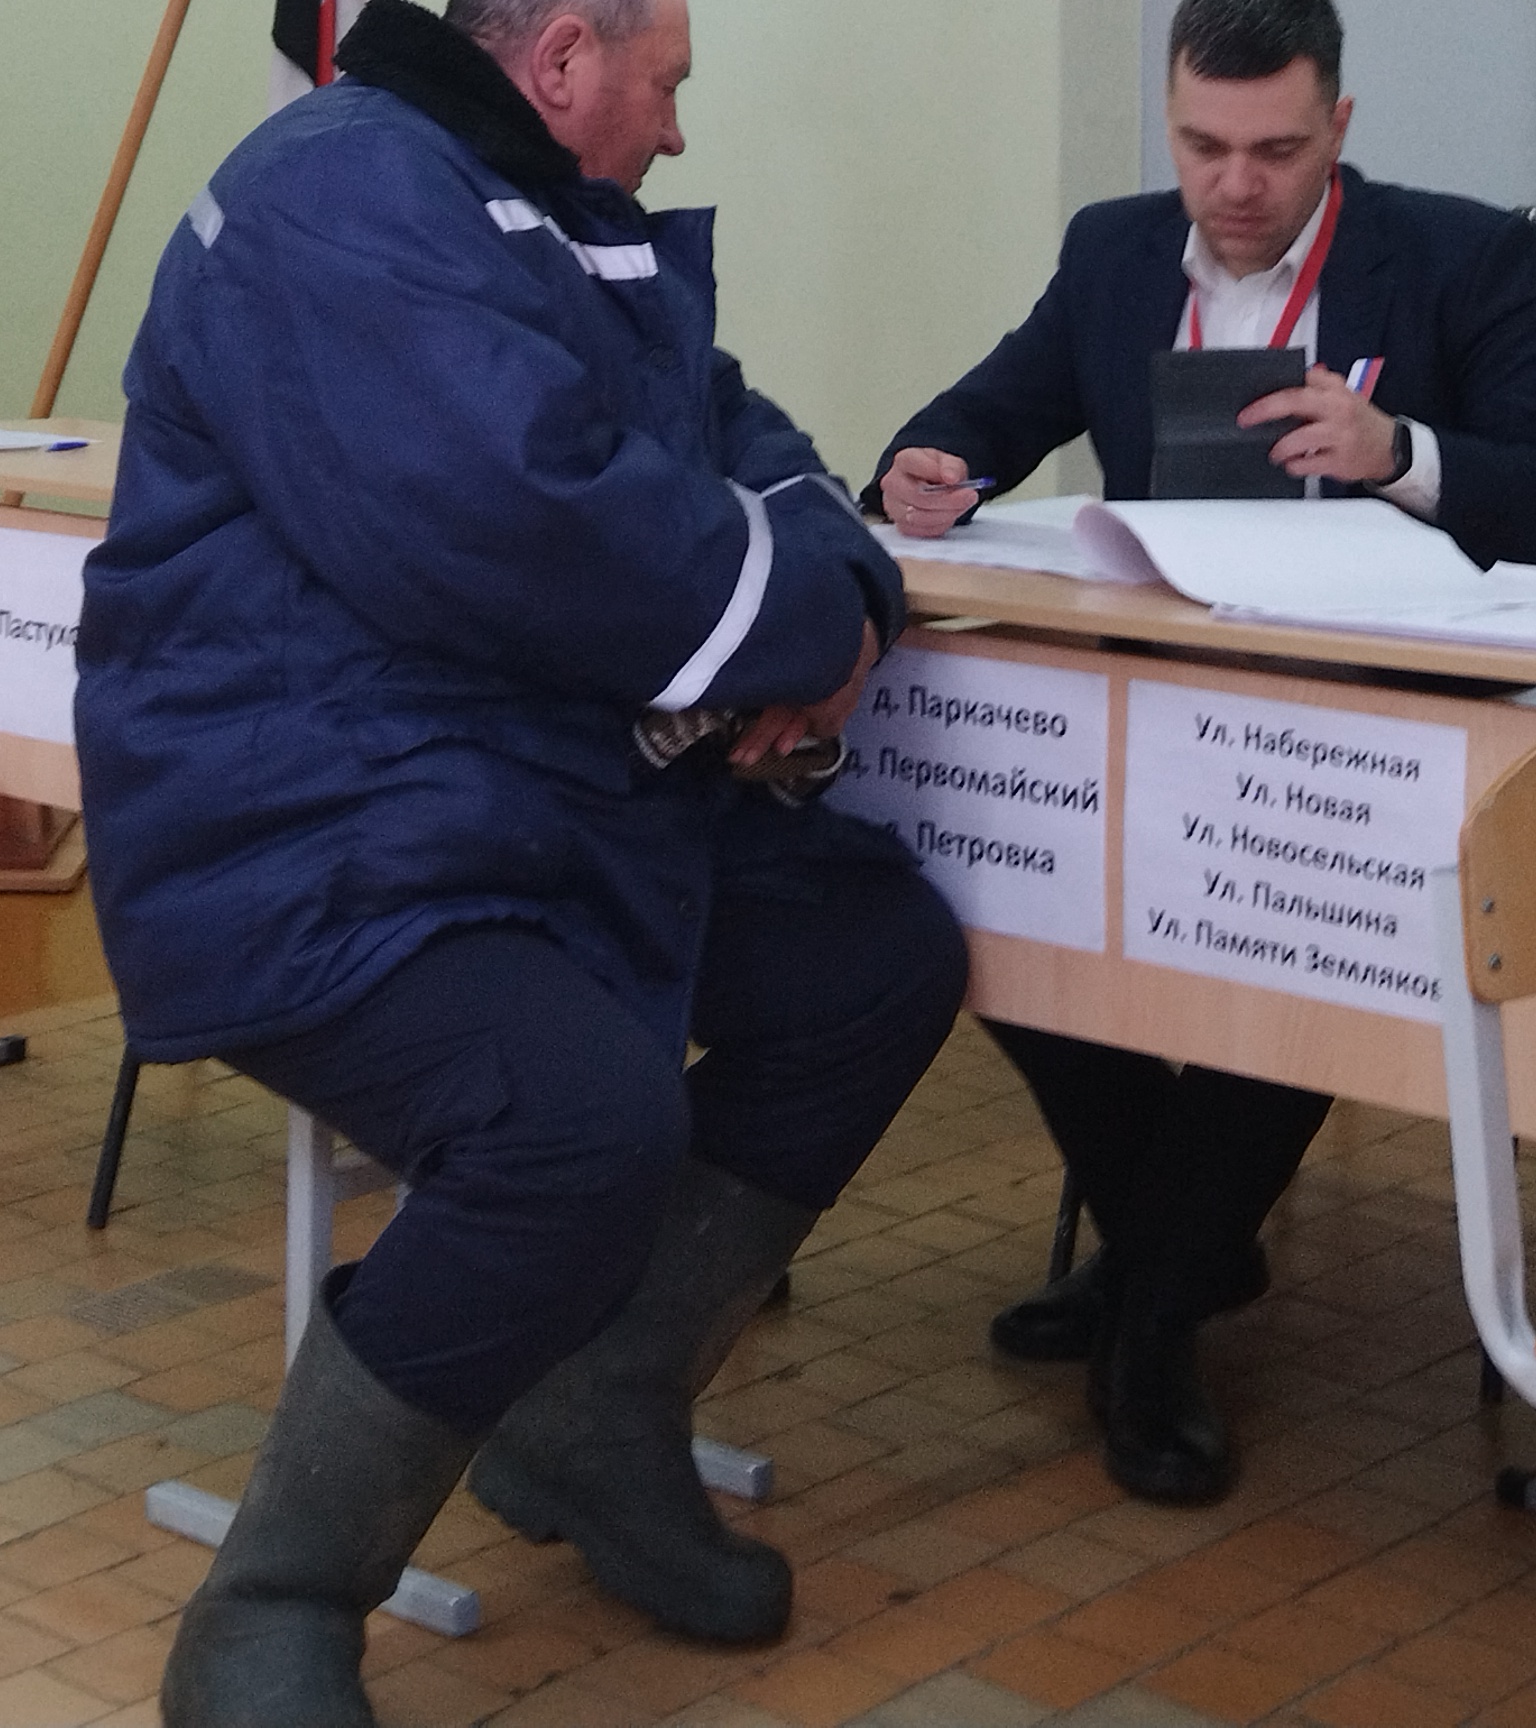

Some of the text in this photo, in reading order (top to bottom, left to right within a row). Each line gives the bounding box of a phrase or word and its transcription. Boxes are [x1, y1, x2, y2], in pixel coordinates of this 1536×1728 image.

[907, 683, 1069, 739] Паркачево
[878, 745, 1101, 816] Первомайский
[1194, 711, 1423, 783] Ул. Набережная
[1235, 771, 1373, 827] Ул. Новая
[916, 819, 1057, 876] Петровка
[1181, 812, 1427, 892] Ул. Новосельская
[1202, 867, 1400, 940] Ул. Пальшина
[1147, 906, 1444, 1004] Ул. Памяти Земляков
